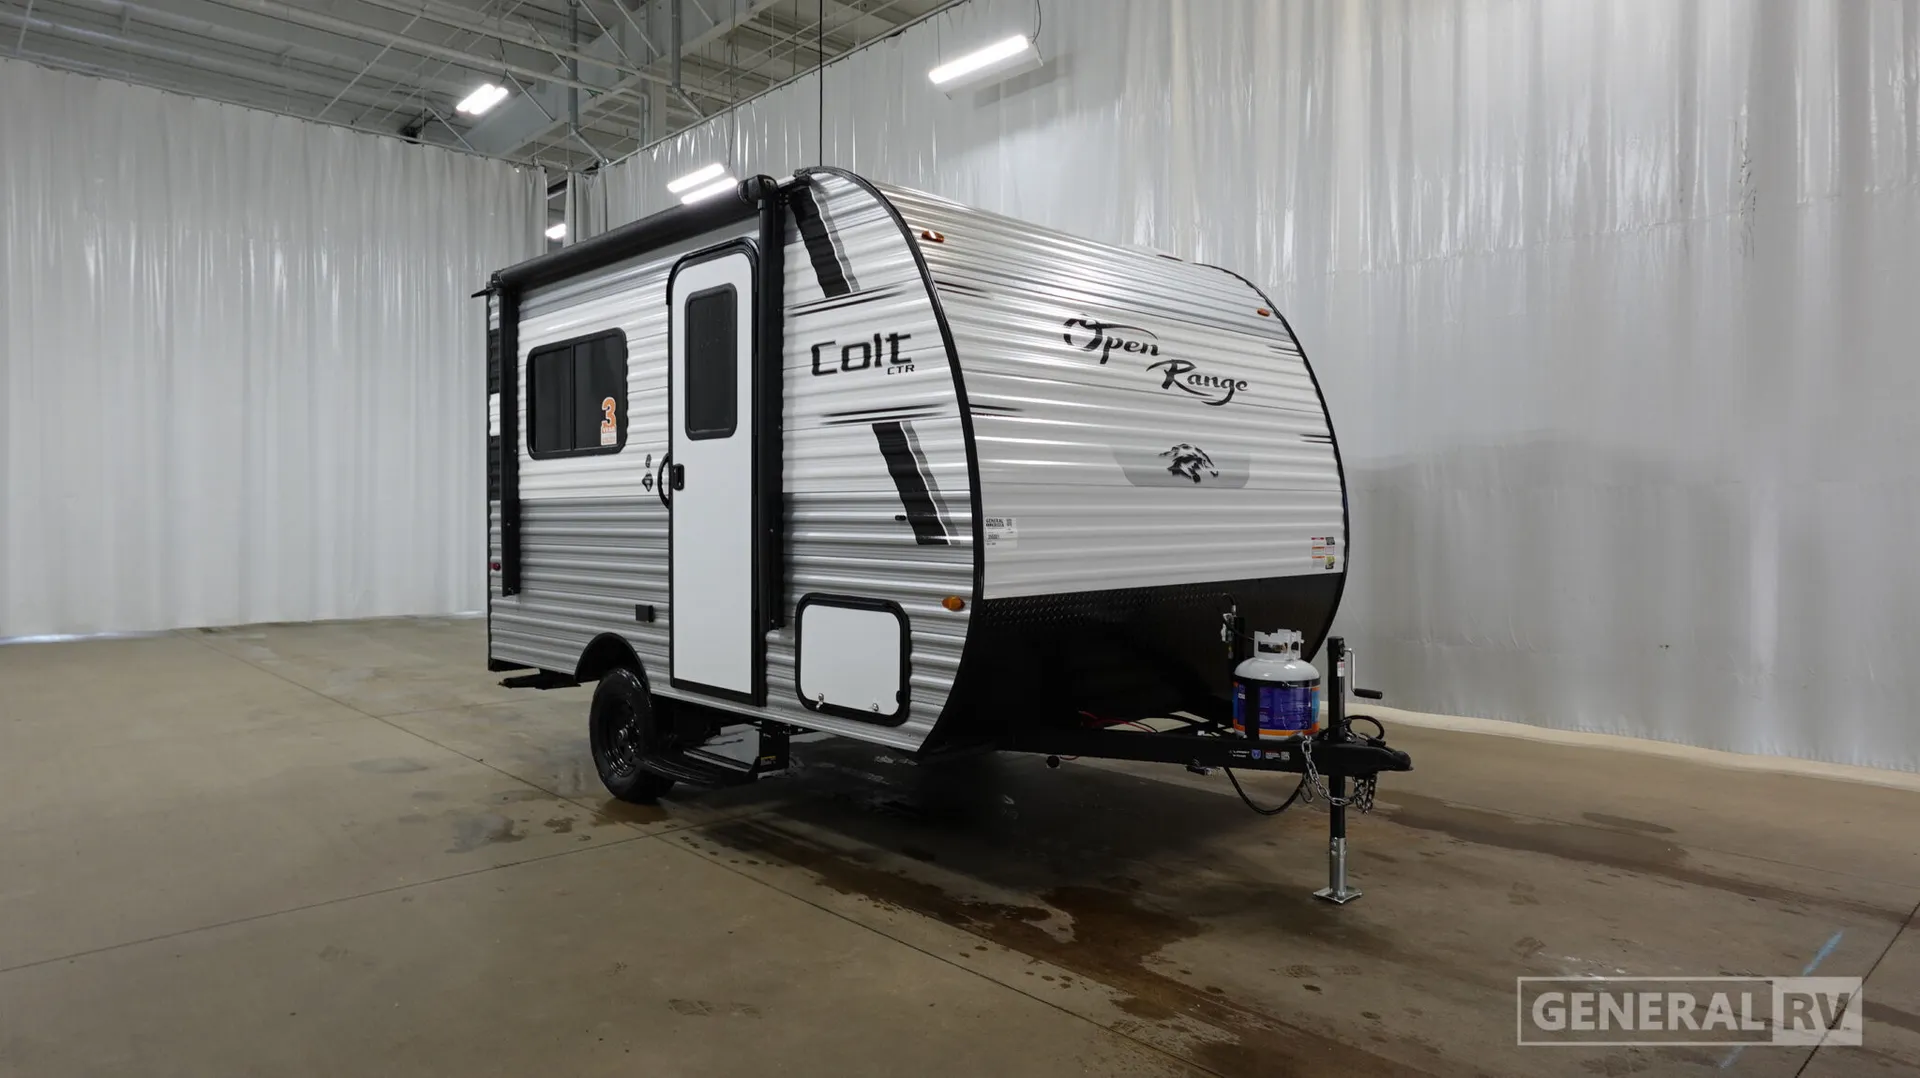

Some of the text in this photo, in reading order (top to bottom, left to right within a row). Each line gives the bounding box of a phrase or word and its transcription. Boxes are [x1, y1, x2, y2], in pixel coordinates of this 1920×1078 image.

[811, 332, 912, 376] Colt
[1063, 314, 1160, 365] Open
[887, 364, 915, 375] CTR
[1146, 359, 1248, 406] Range
[602, 397, 616, 427] 3
